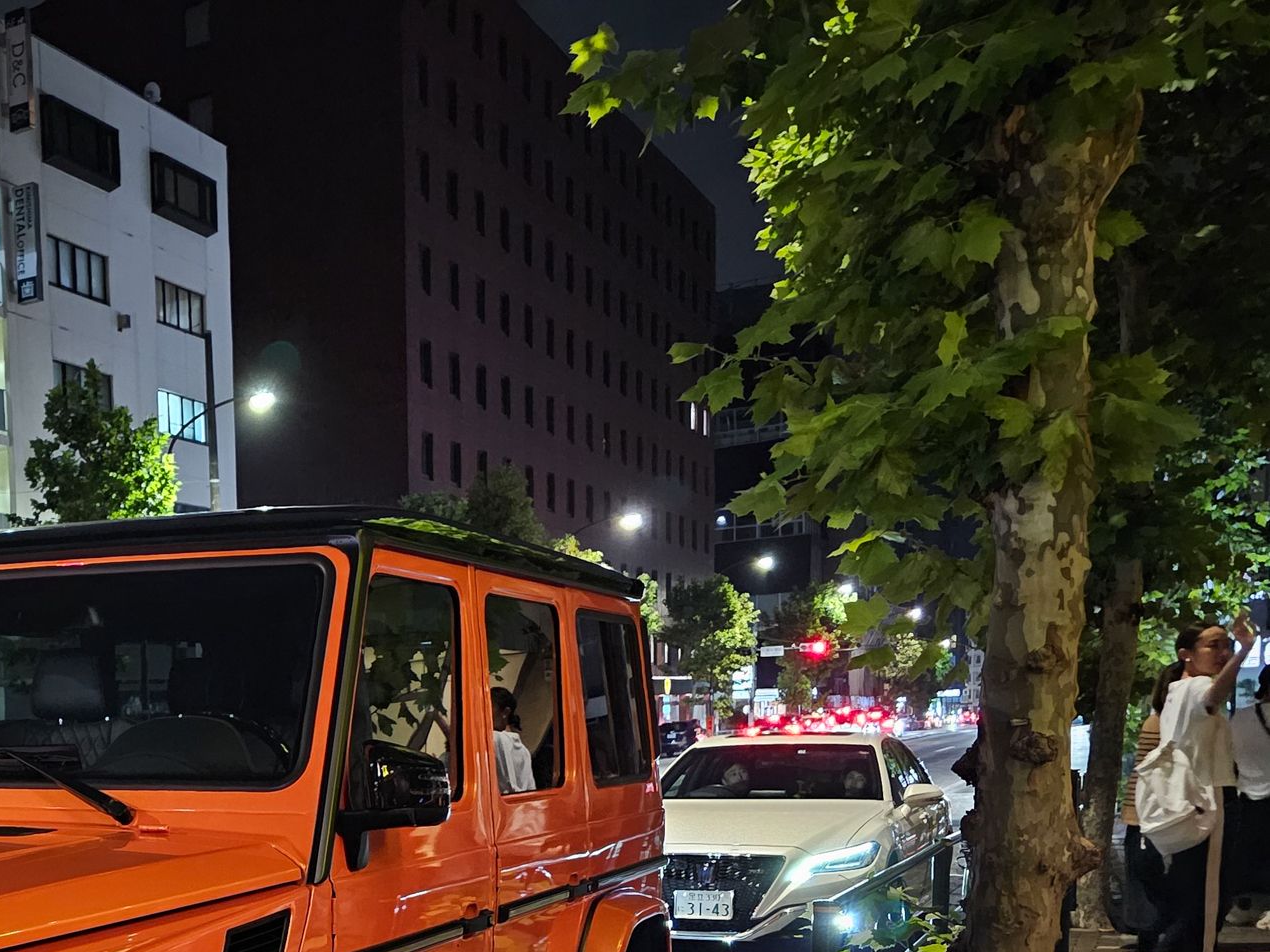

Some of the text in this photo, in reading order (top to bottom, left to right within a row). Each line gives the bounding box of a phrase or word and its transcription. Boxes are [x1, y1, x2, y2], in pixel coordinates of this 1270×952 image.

[12, 41, 26, 88] D&C
[14, 188, 27, 276] DENTAL OFFICE
[687, 902, 729, 917] 31-43
